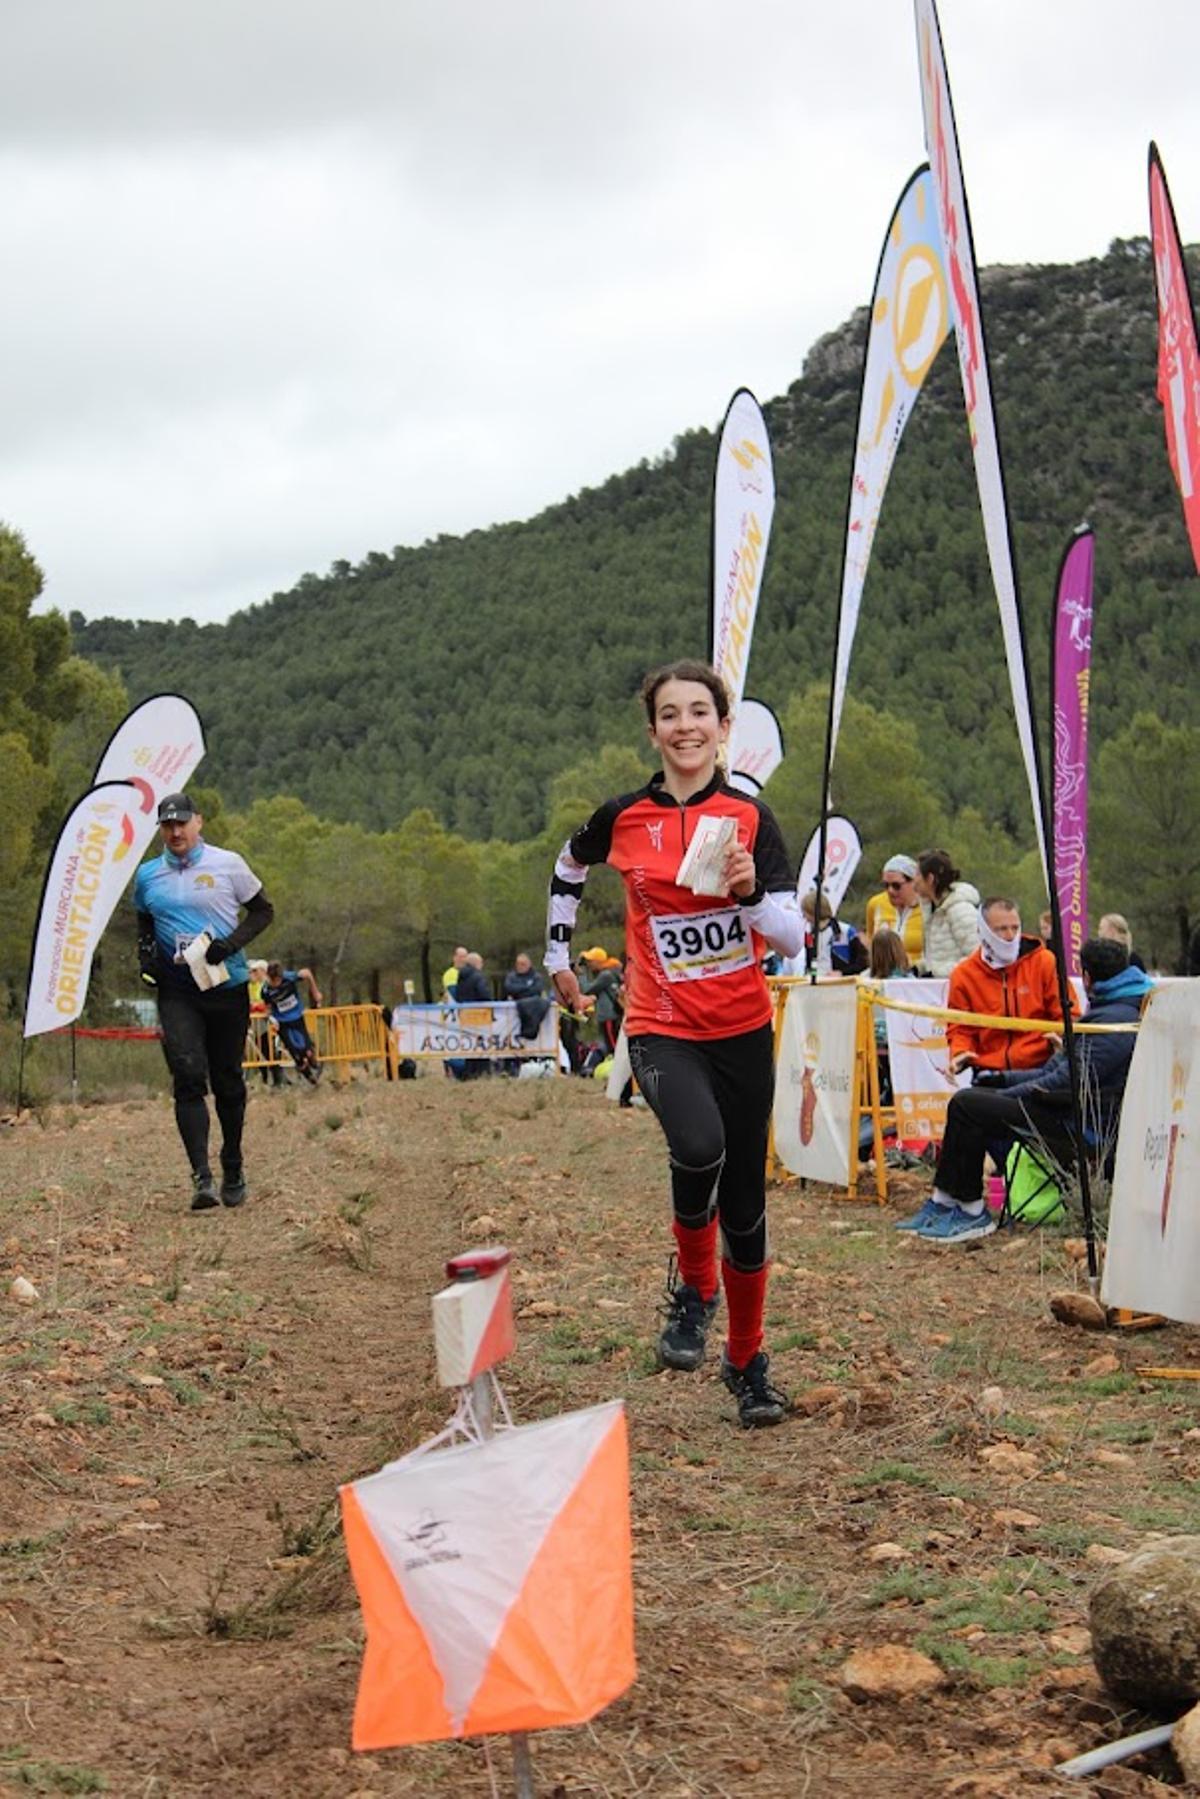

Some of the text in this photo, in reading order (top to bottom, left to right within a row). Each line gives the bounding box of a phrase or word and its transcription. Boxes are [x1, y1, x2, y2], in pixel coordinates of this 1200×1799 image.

[54, 855, 80, 937] MURCIANA
[56, 822, 111, 1016] ORIENTACIÓN
[659, 915, 746, 959] 3904
